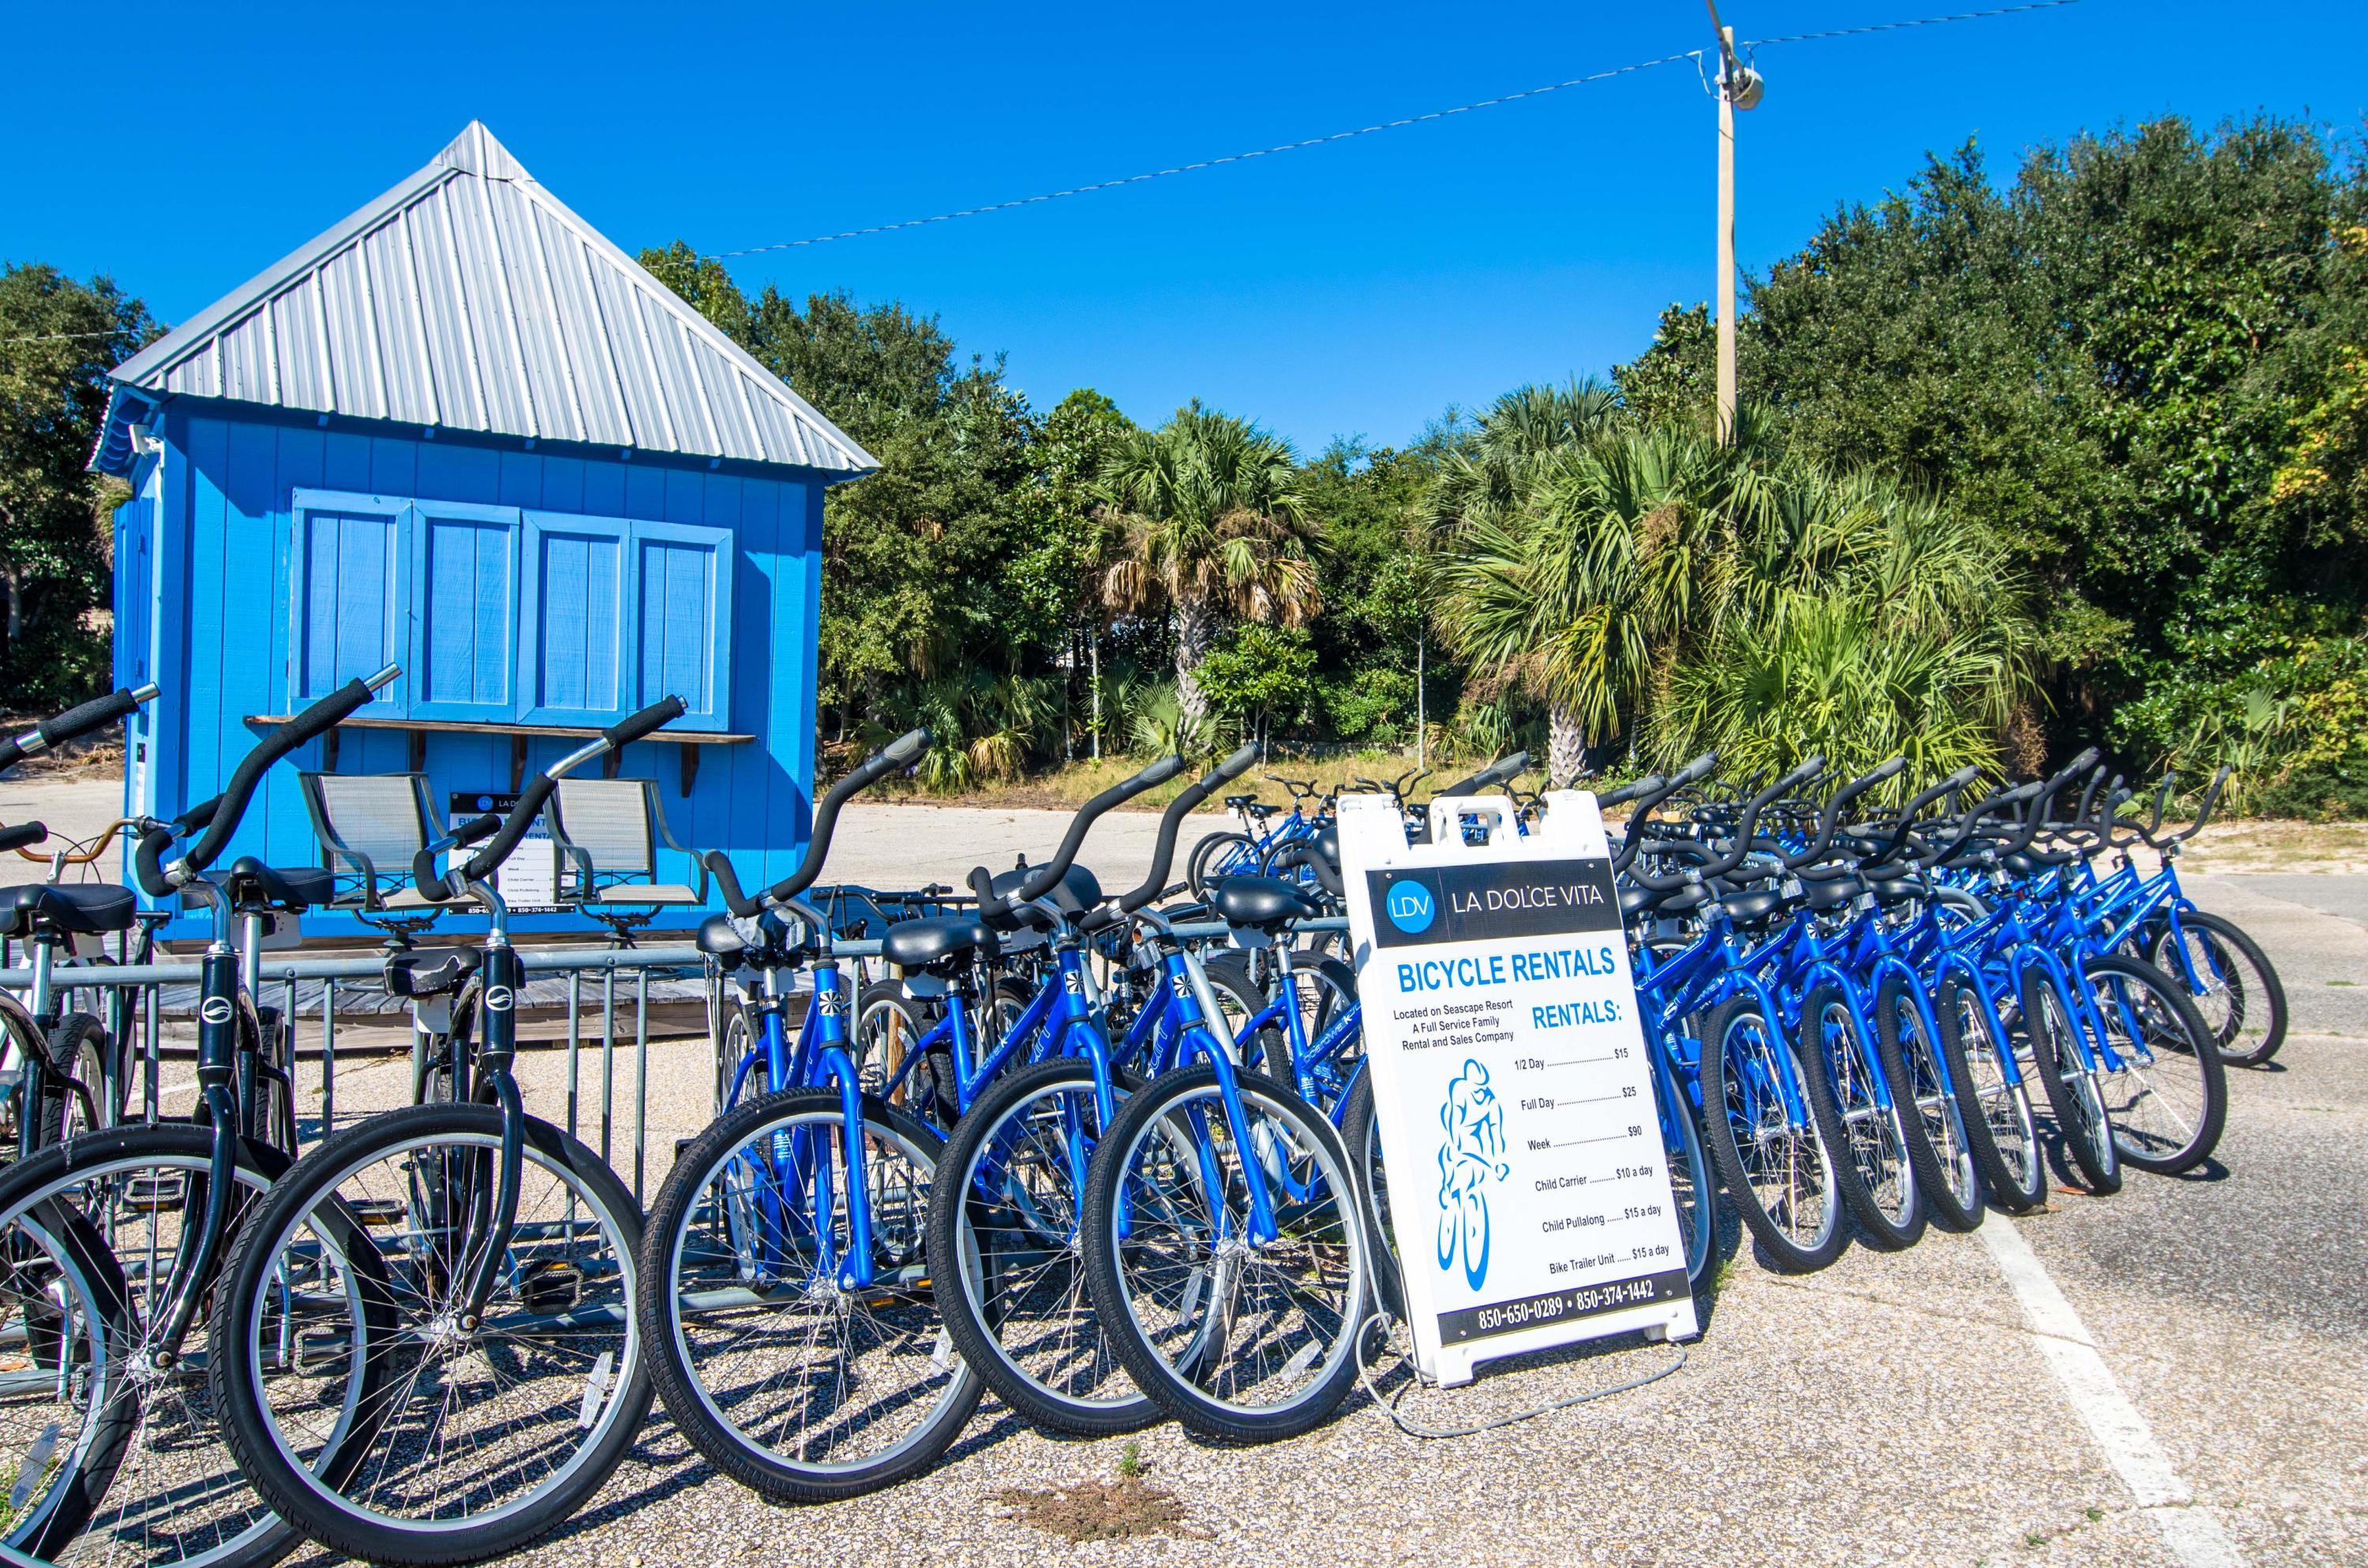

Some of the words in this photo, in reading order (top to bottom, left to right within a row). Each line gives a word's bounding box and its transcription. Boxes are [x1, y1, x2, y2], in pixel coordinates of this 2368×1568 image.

[1391, 895, 1429, 918] LDV
[1452, 891, 1482, 913] LA
[1486, 886, 1558, 911] DOLCE
[1559, 885, 1605, 906] VITA
[1397, 956, 1506, 993] BICYCLE
[1512, 947, 1615, 982] RENTALS
[1393, 1007, 1429, 1020] Located
[1430, 1007, 1441, 1016] on
[1443, 1003, 1484, 1015] Seascape
[1486, 999, 1513, 1010] Resort
[1532, 999, 1622, 1030] RENTALS:
[1413, 1024, 1419, 1034] A
[1421, 1021, 1437, 1033] Full
[1439, 1020, 1471, 1031] Service
[1472, 1016, 1500, 1027] Family
[1402, 1038, 1429, 1050] Rental
[1432, 1036, 1448, 1047] and
[1450, 1035, 1473, 1046] Sales
[1475, 1031, 1514, 1043] Company
[1514, 1059, 1527, 1071] 1/2
[1529, 1058, 1545, 1070] Day
[1614, 1048, 1628, 1059] $15
[1521, 1098, 1537, 1110] Full
[1538, 1098, 1554, 1110] Day
[1622, 1086, 1636, 1098] $25
[1527, 1138, 1551, 1151] Week
[1628, 1125, 1642, 1137] $90
[1534, 1178, 1557, 1192] Child
[1559, 1175, 1587, 1188] Carrier
[1616, 1168, 1631, 1179] $10
[1639, 1166, 1653, 1177] day
[1542, 1219, 1564, 1233] Child
[1566, 1214, 1605, 1229] Pullalong
[1624, 1207, 1639, 1219] $15
[1647, 1204, 1662, 1216] day
[1549, 1262, 1568, 1274] Bike
[1569, 1257, 1596, 1270] Trailer
[1597, 1253, 1615, 1266] Unit
[1632, 1248, 1647, 1259] $15
[1655, 1244, 1669, 1256] day
[1478, 1296, 1564, 1330] 850-650-0289
[1576, 1279, 1654, 1311] 850-374-1442
